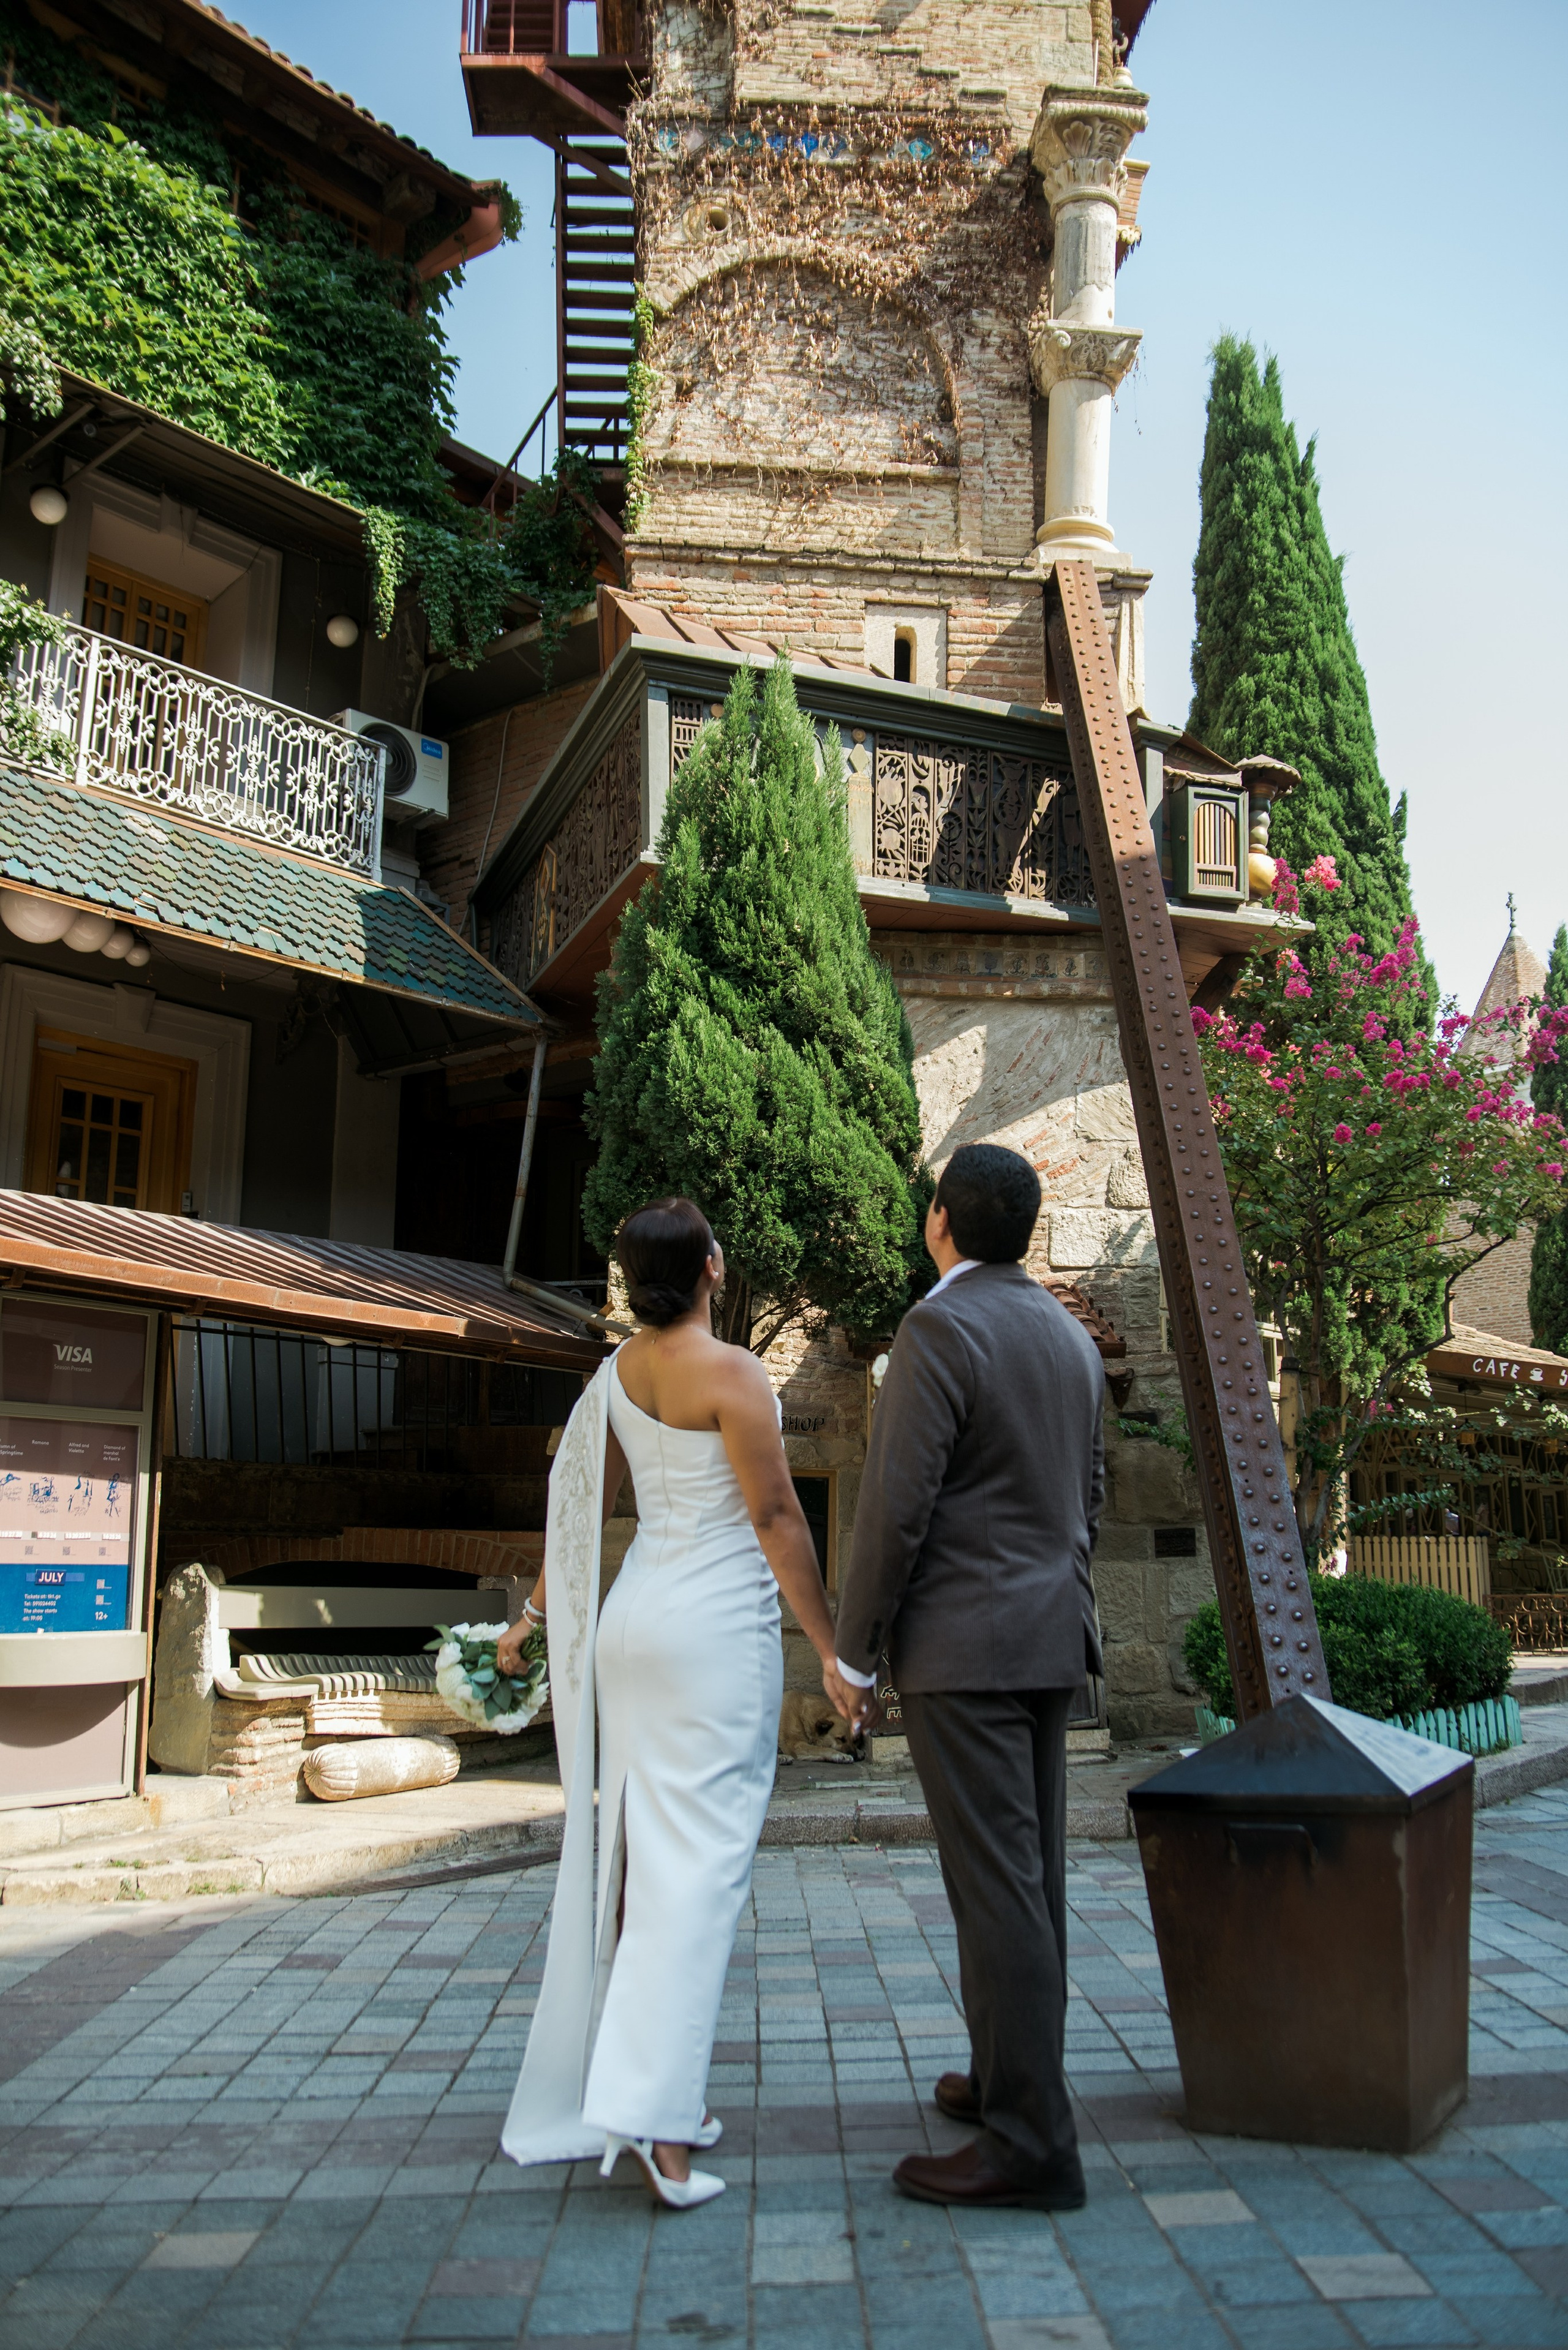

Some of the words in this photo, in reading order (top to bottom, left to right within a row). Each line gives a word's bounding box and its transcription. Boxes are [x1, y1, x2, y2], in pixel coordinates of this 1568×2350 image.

[53, 1344, 92, 1363] VISA
[1472, 1358, 1521, 1379] CAFE
[782, 1415, 825, 1432] SHOP
[39, 1572, 64, 1583] JULY
[95, 1611, 108, 1621] 12+
